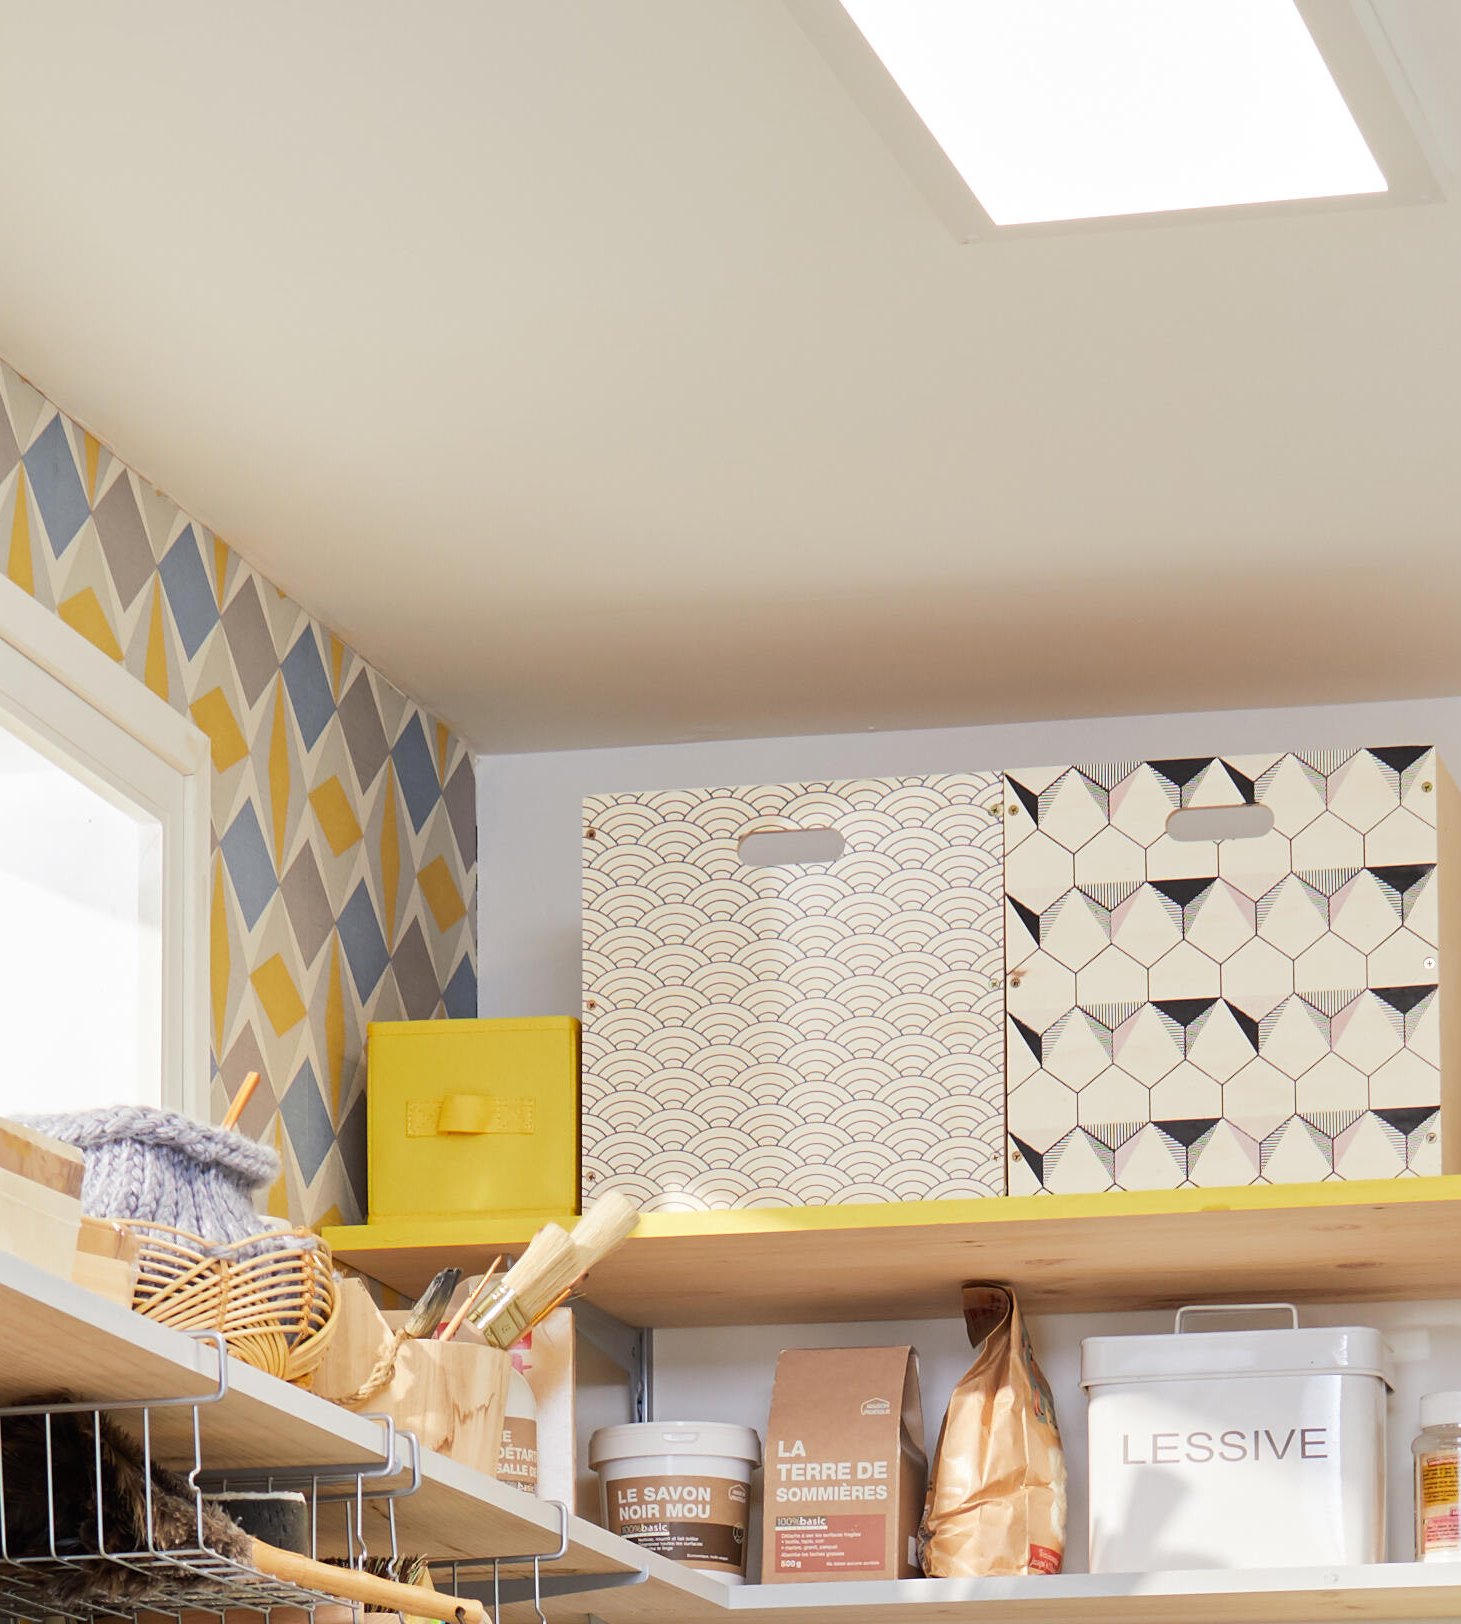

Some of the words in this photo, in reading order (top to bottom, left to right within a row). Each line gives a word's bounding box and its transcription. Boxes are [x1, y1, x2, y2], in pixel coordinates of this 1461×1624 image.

[777, 1439, 807, 1458] LA
[1122, 1427, 1329, 1465] LESSIVE
[776, 1461, 852, 1482] TERRE
[856, 1460, 888, 1480] DE
[618, 1488, 639, 1504] LE
[643, 1486, 712, 1502] SAVON
[775, 1482, 888, 1503] SOMMIÈRES
[619, 1503, 661, 1521] NOIR
[665, 1503, 711, 1519] MOU
